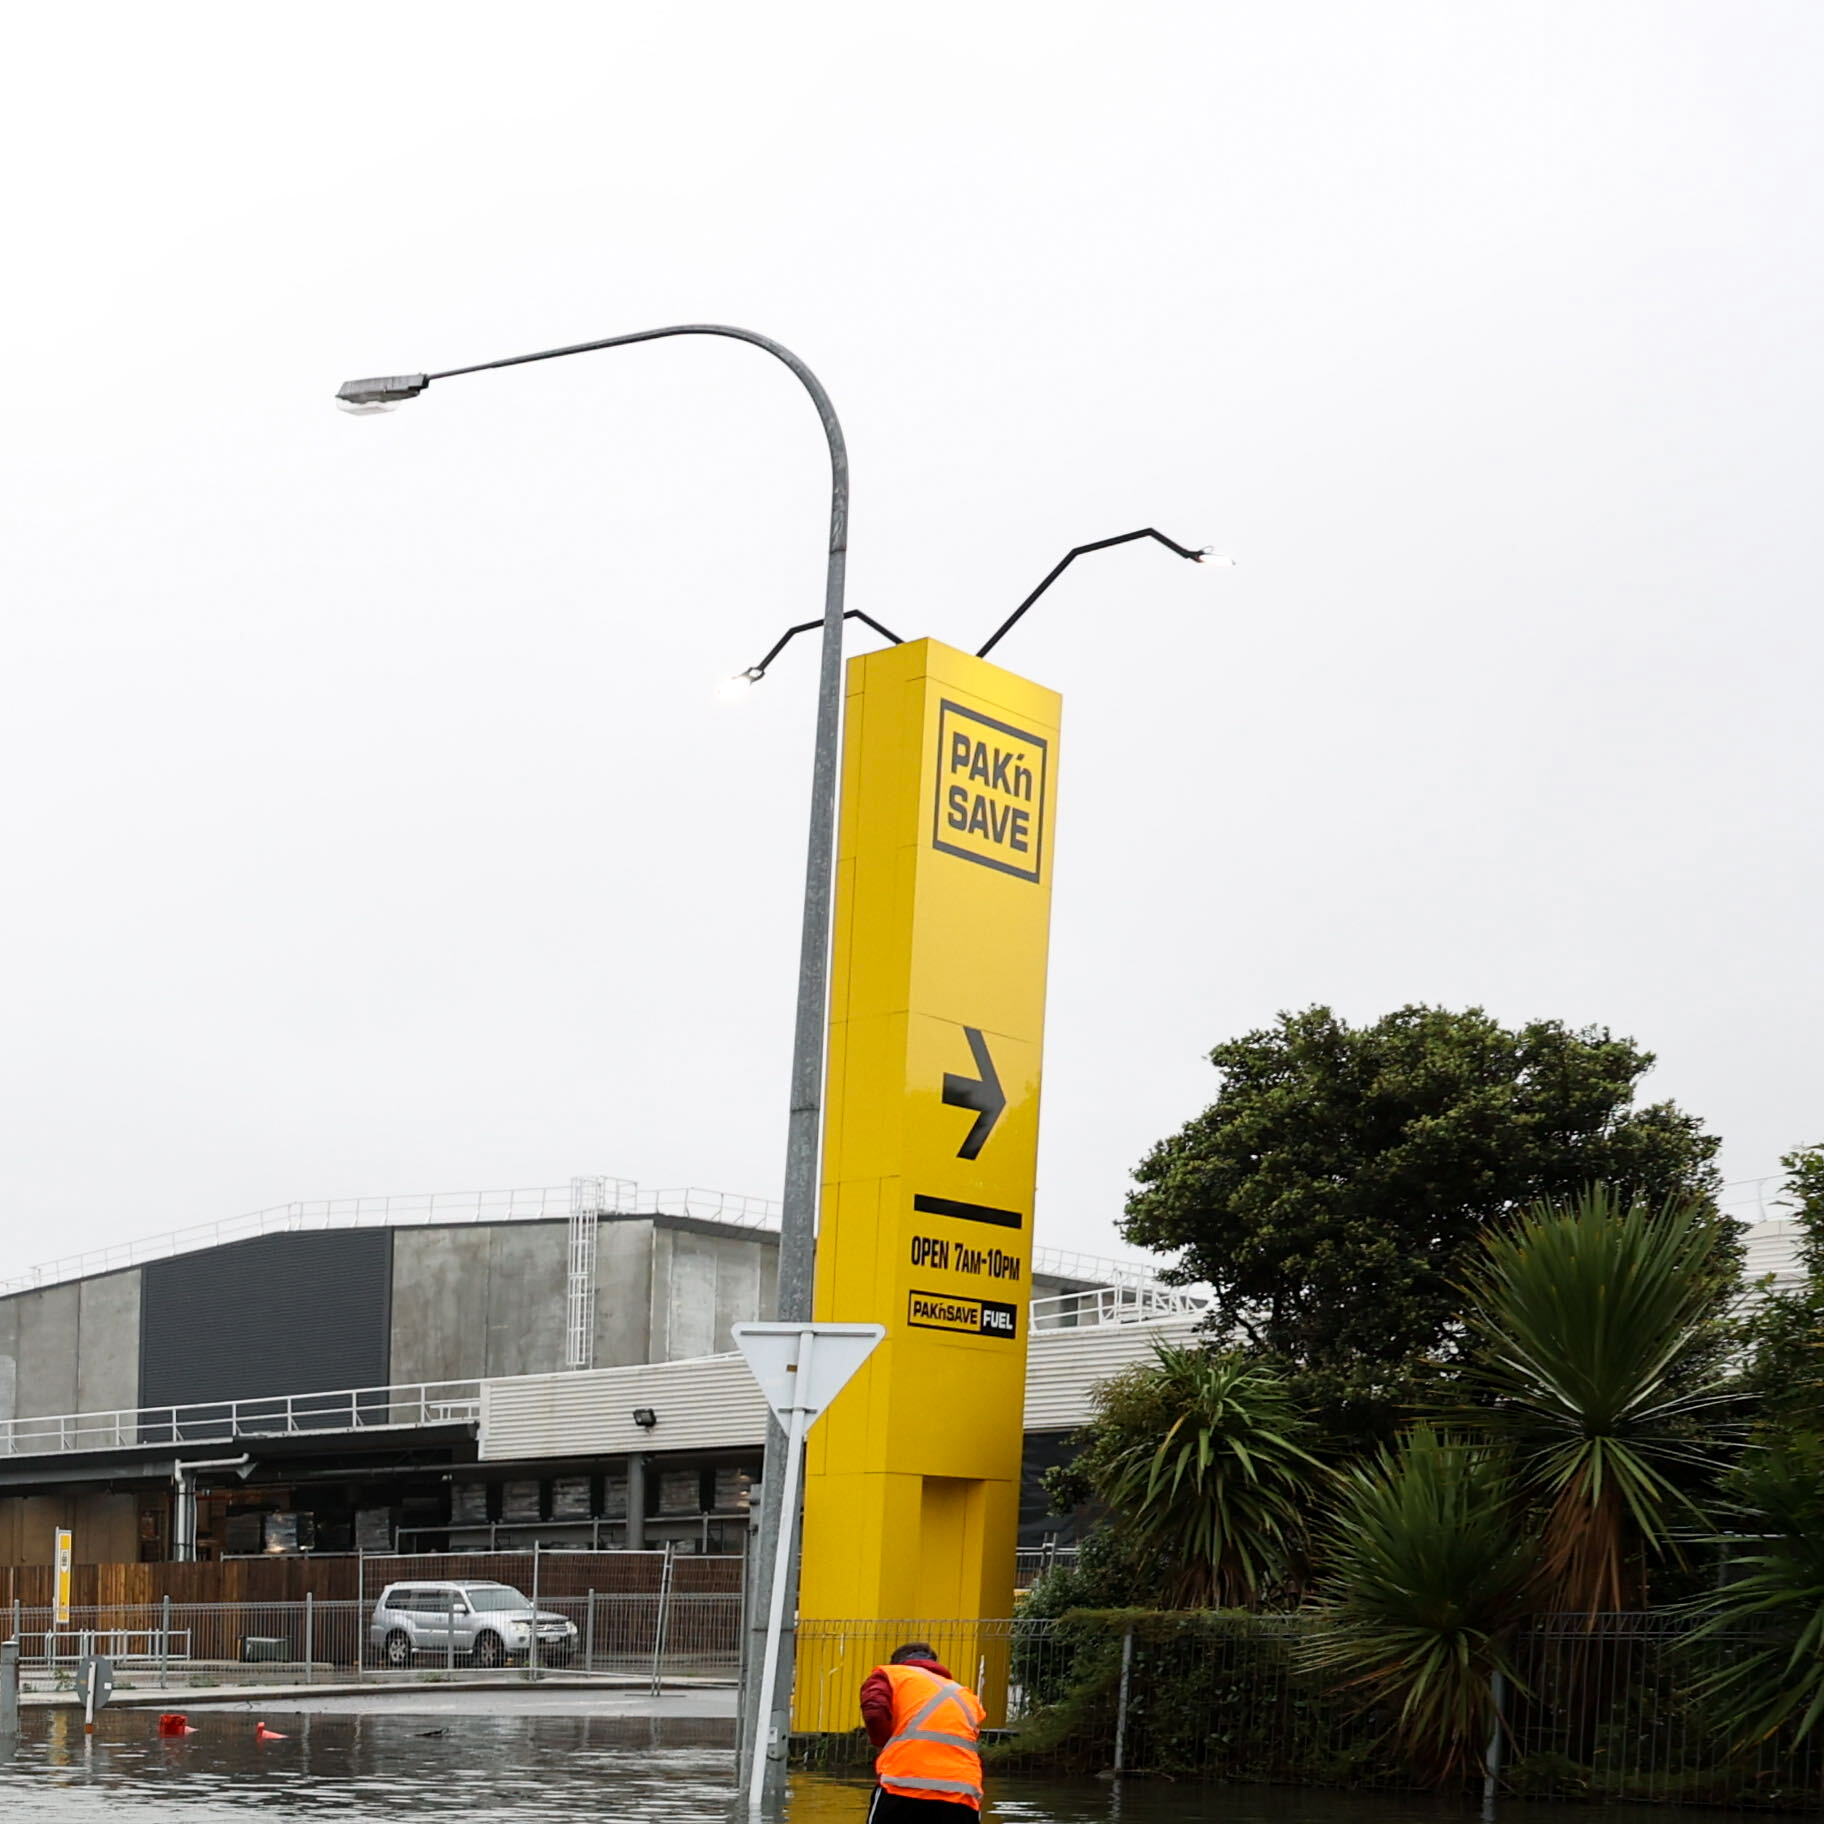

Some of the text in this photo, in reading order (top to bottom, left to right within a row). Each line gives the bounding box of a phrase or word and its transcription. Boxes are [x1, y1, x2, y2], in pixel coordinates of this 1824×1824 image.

[948, 785, 1030, 853] SAVE
[912, 1236, 949, 1270] OPEN
[983, 1309, 1013, 1330] FUEL
